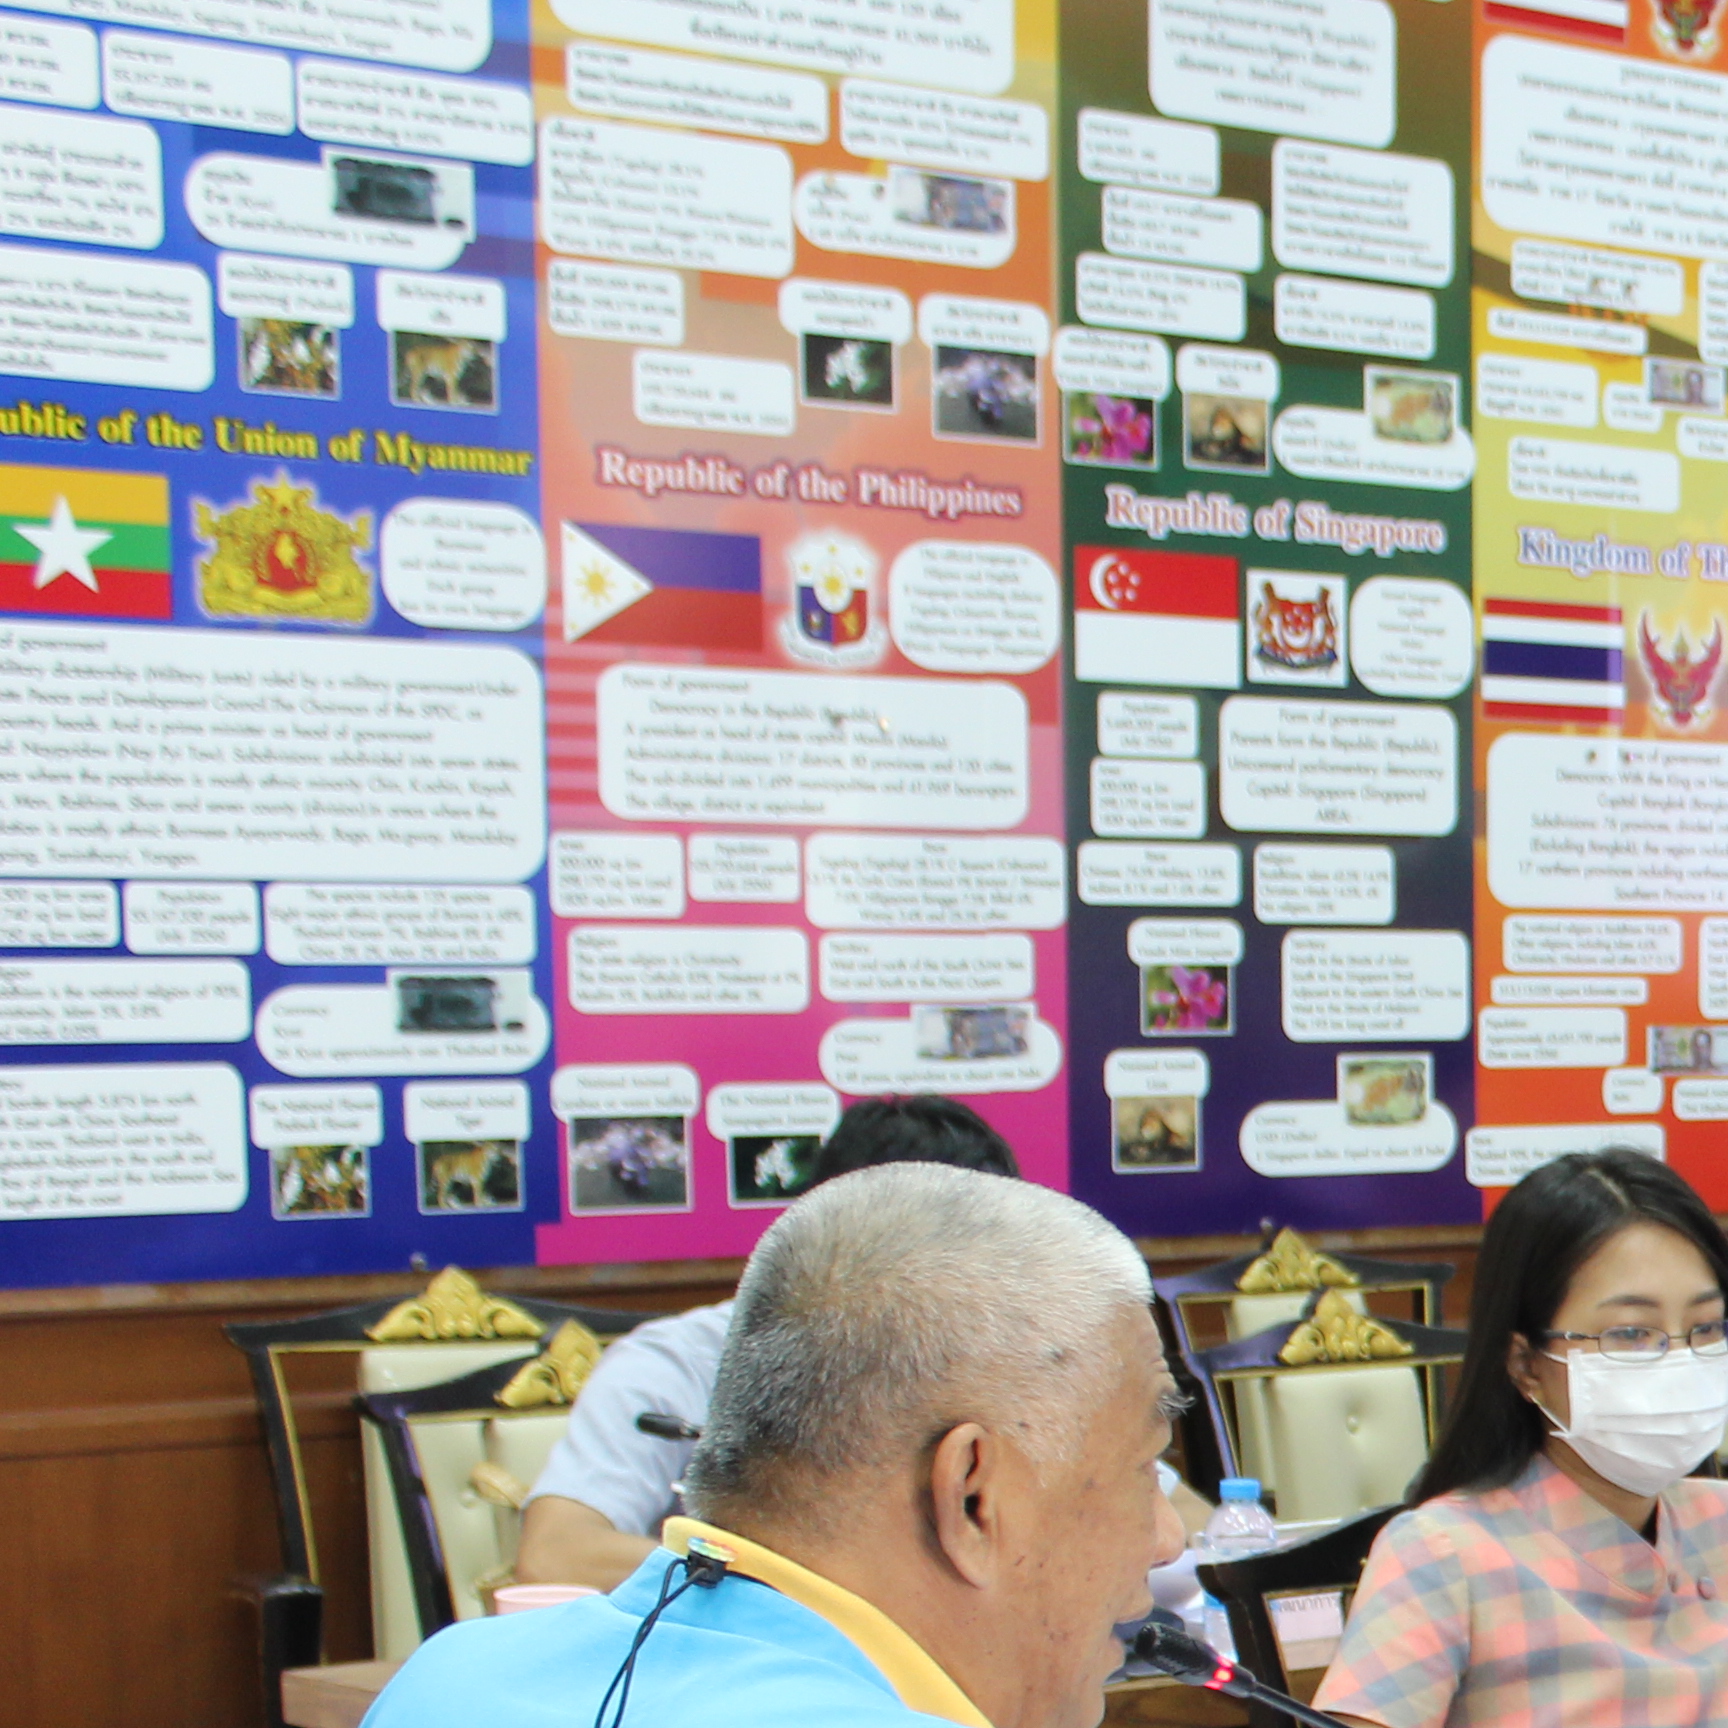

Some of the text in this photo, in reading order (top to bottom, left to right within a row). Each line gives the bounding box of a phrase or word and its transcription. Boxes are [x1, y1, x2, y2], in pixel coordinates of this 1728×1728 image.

[98, 413, 138, 444] of
[145, 415, 203, 450] the
[215, 417, 318, 459] Union
[329, 430, 365, 463] of
[374, 431, 533, 476] Myanmar
[600, 450, 1023, 519] Republic of the Philippines
[1106, 485, 1446, 556] Republic of Singapore
[1518, 529, 1650, 577] Kingdom
[1660, 544, 1691, 578] of
